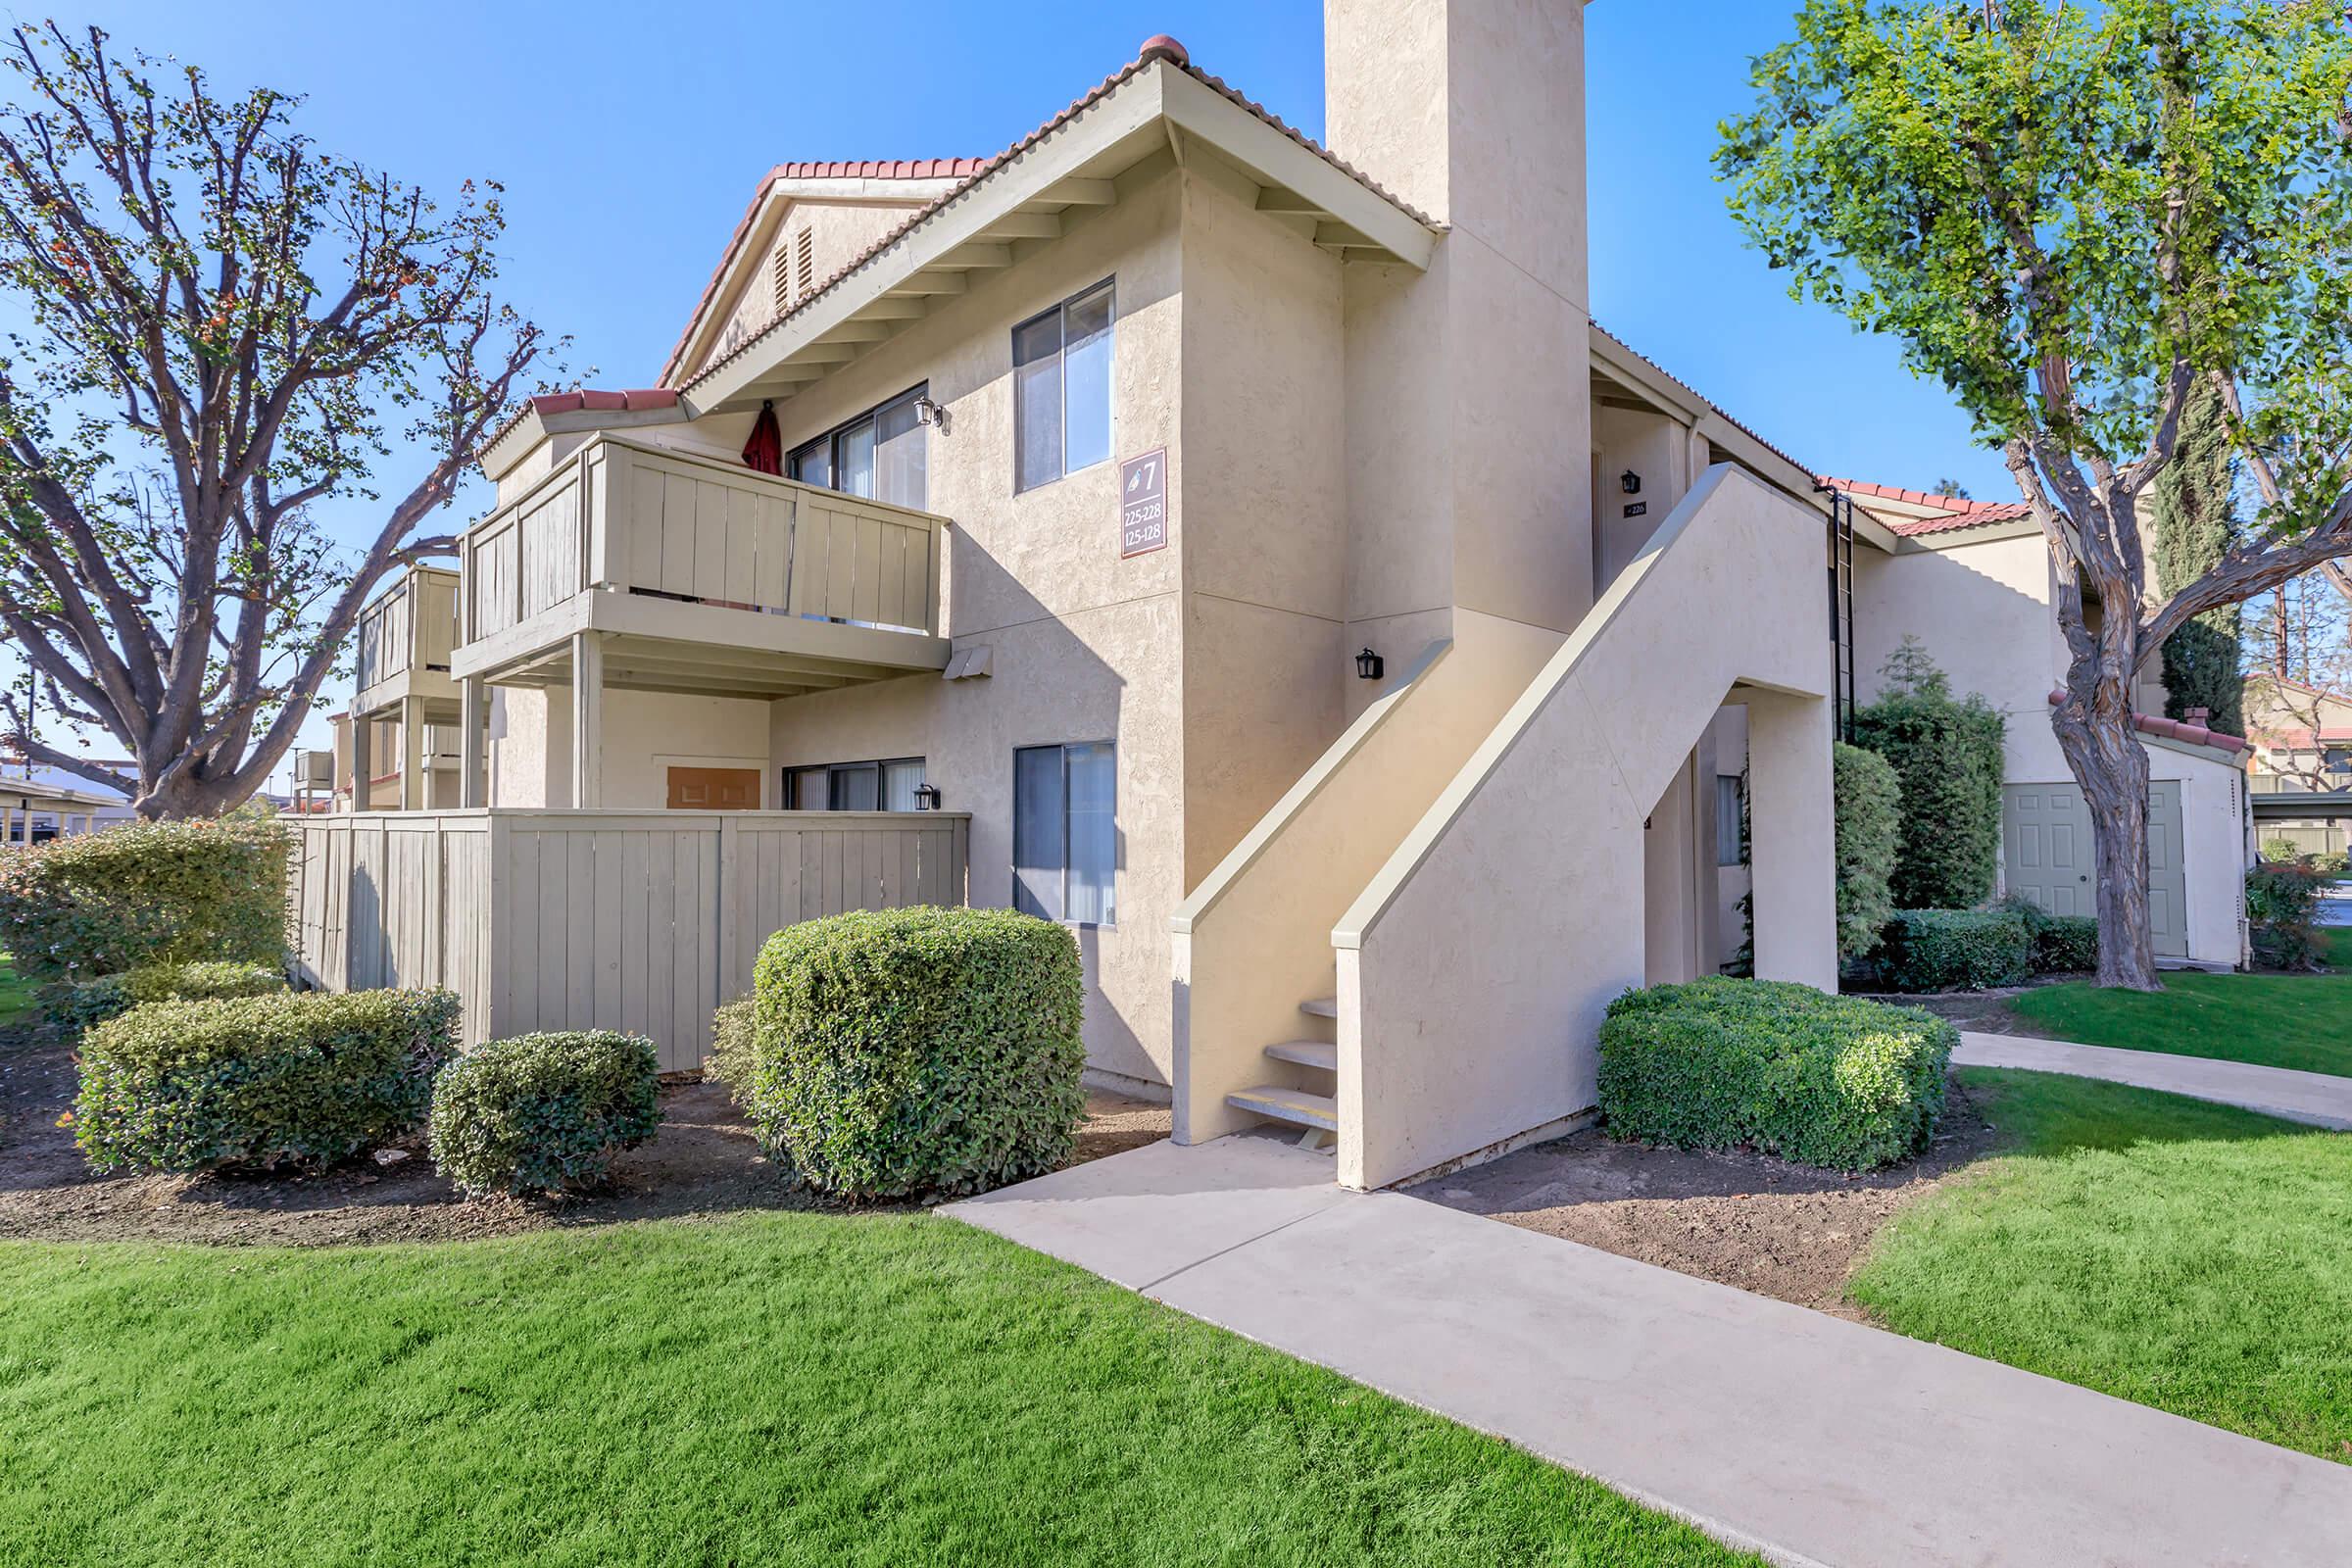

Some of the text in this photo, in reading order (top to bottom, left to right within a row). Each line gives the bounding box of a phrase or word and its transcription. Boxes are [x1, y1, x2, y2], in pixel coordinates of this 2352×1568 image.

[1144, 461, 1156, 490] 7
[1125, 503, 1161, 527] 225-228
[1125, 523, 1161, 547] 125-128
